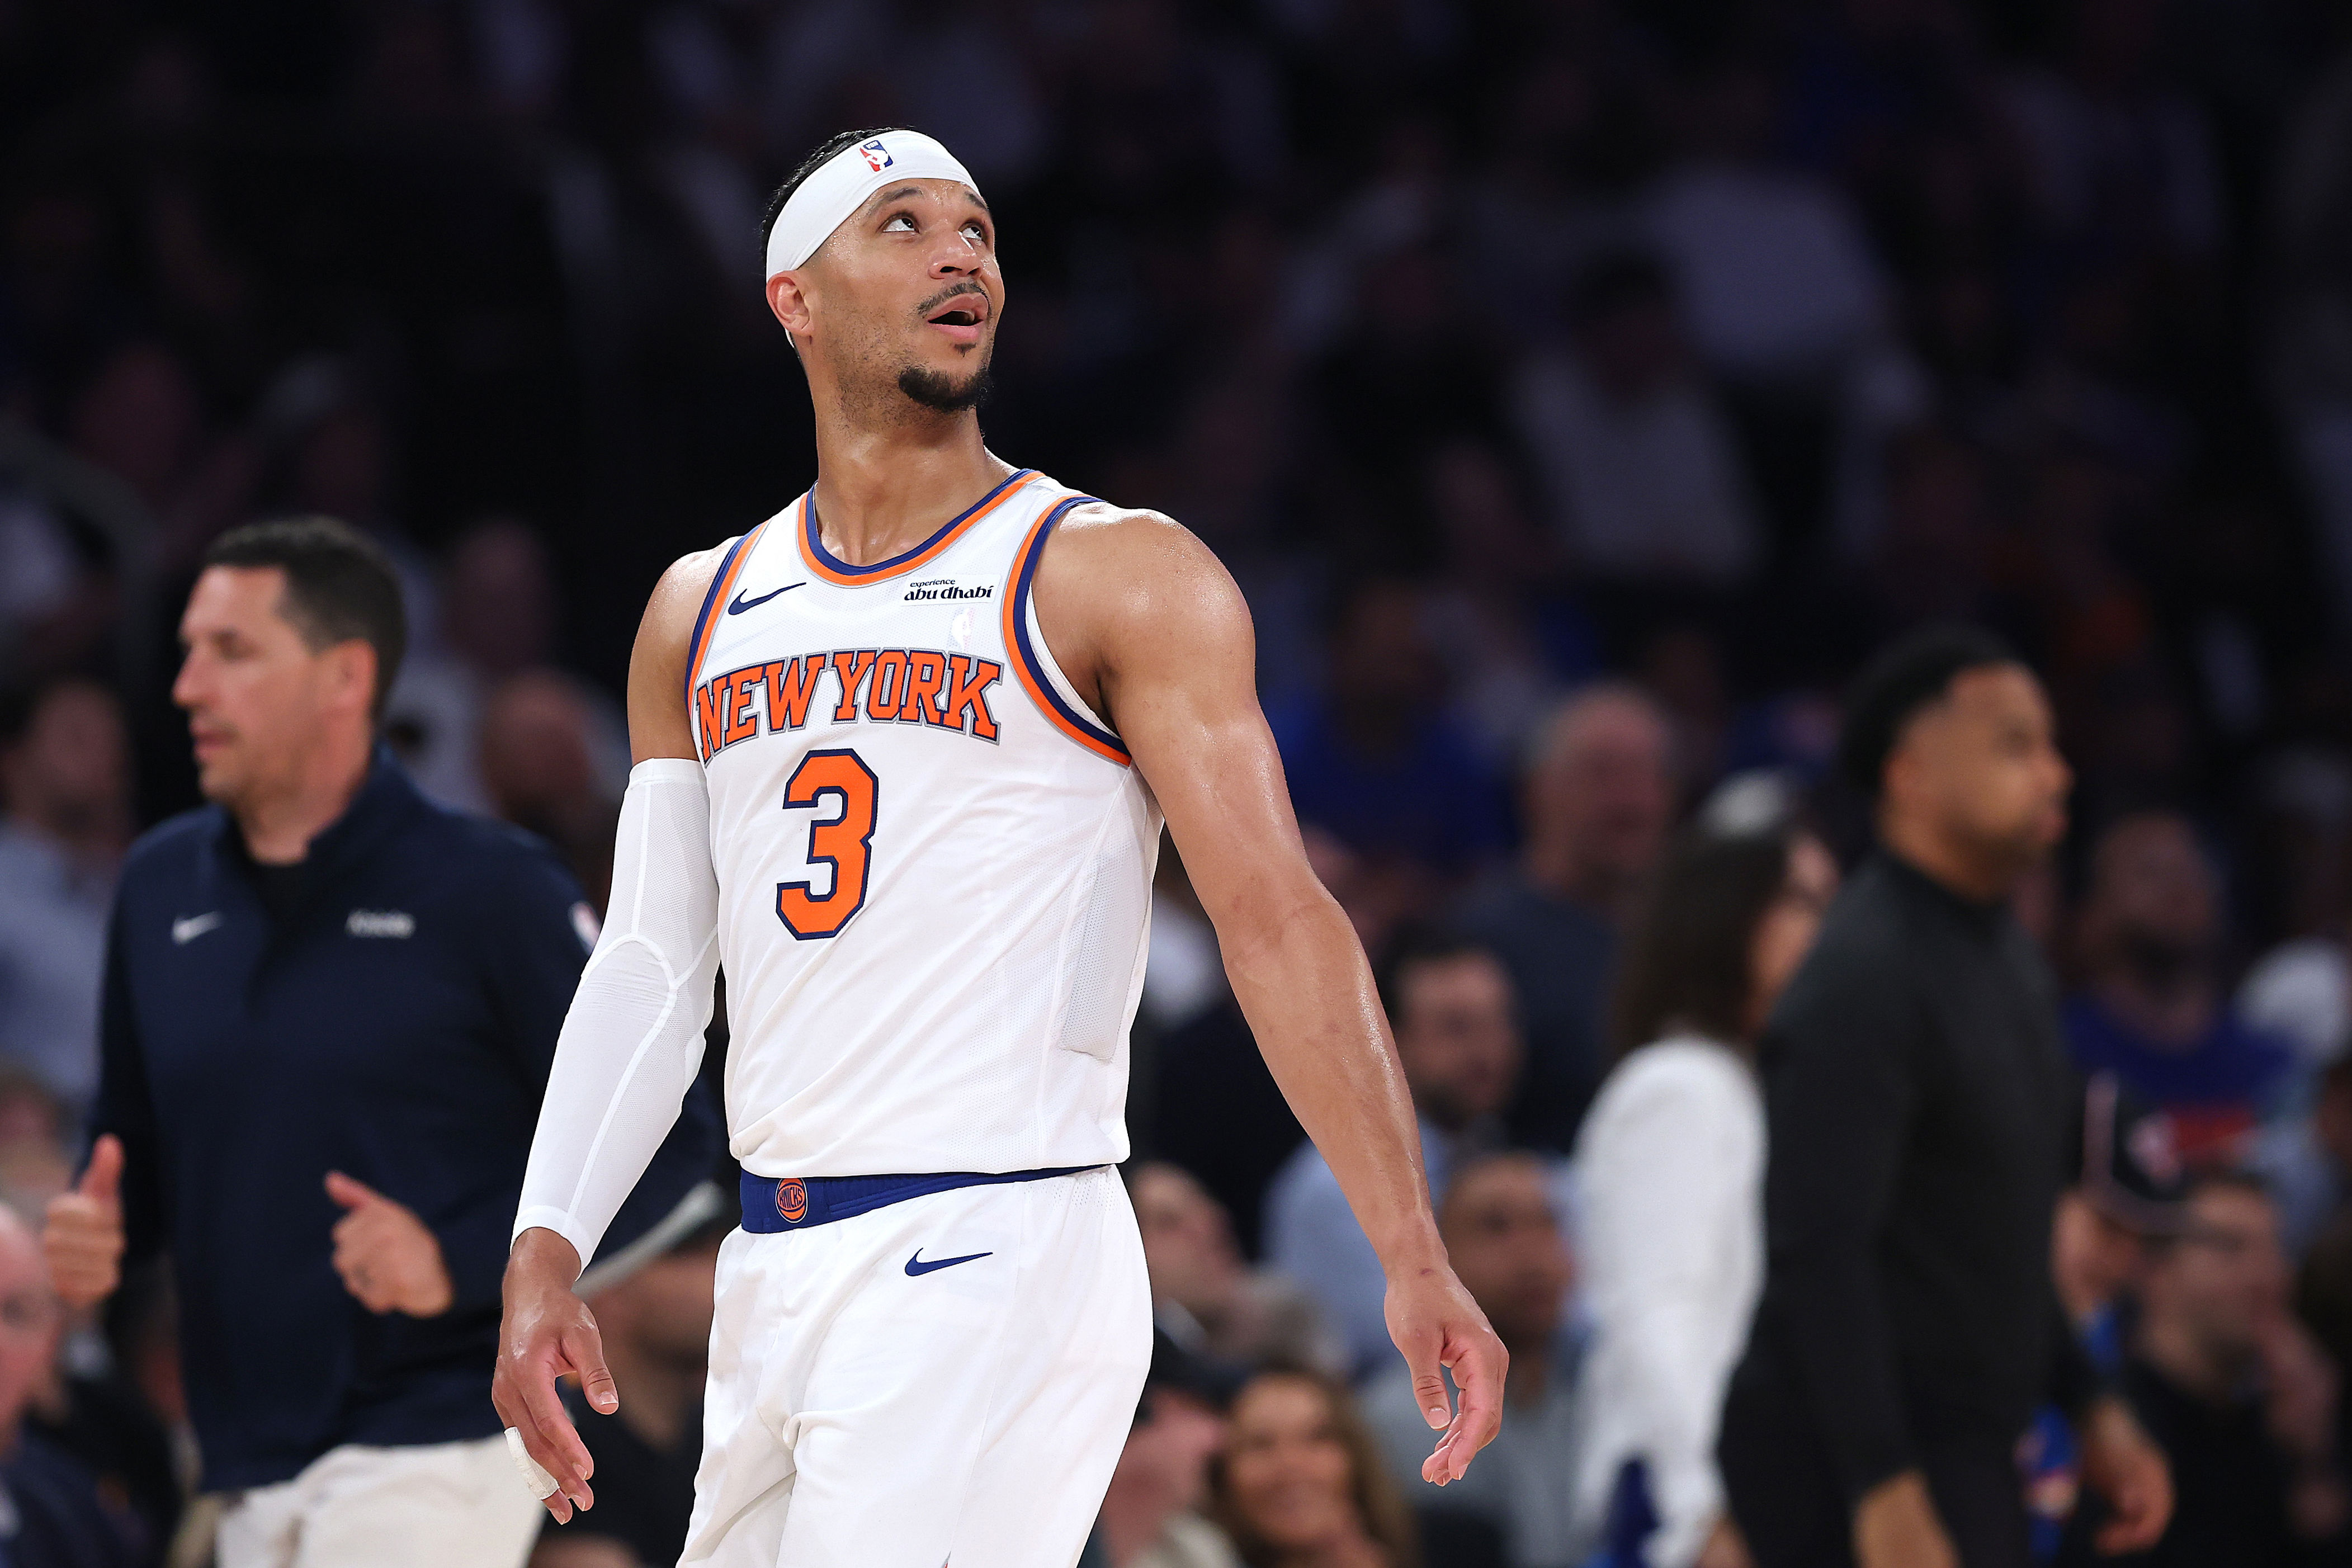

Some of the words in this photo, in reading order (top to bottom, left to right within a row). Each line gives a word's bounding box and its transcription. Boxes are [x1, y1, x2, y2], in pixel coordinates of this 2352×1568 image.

[904, 588, 938, 601] abu
[941, 585, 994, 599] dhabi
[910, 579, 955, 588] experience
[695, 650, 826, 768] NEW
[830, 647, 1005, 745] YORK
[776, 748, 879, 941] 3
[779, 1186, 802, 1209] KNICKS
